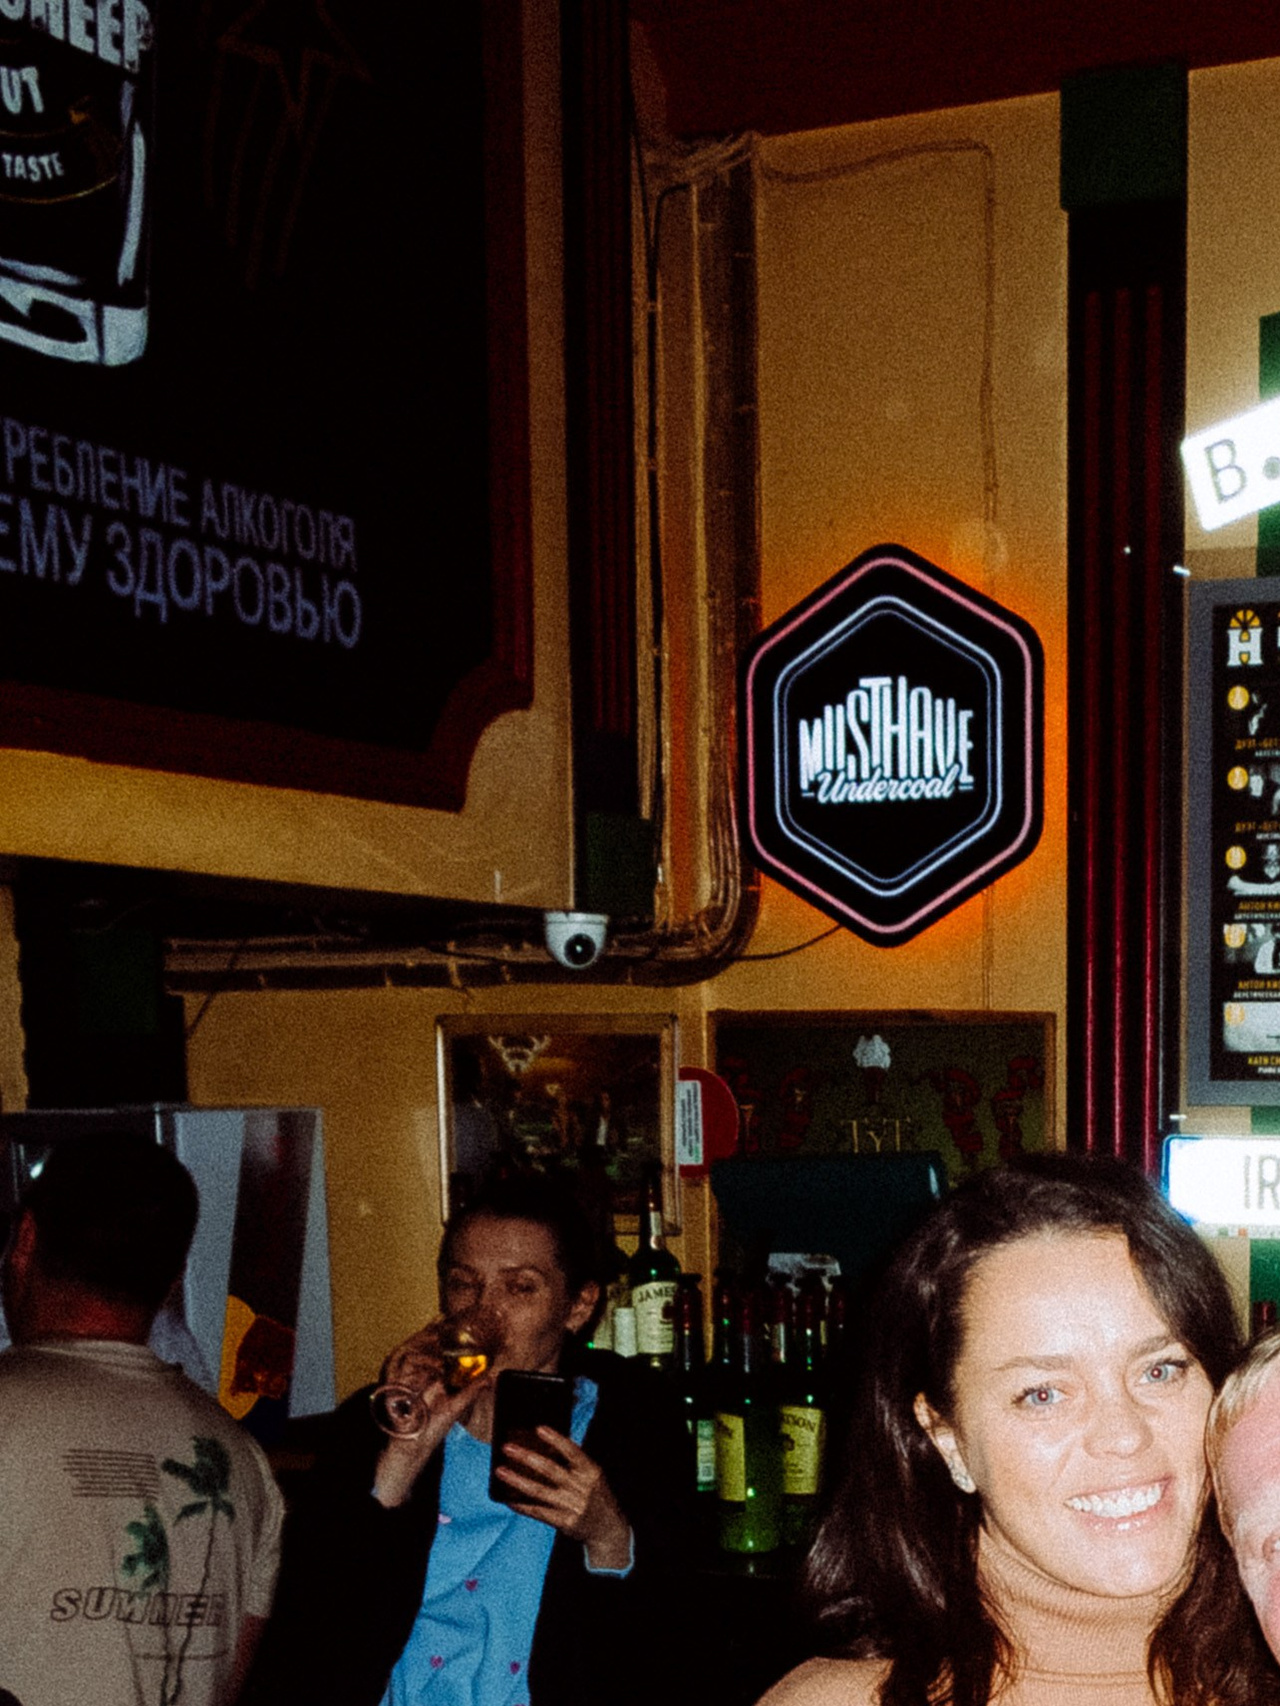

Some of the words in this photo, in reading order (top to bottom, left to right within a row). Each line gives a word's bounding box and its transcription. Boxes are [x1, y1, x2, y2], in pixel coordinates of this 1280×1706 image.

[2, 152, 64, 182] TASTE
[3, 418, 191, 528] РЕБЛЕНИЕ
[201, 479, 358, 572] АЛКОГОЛЯ
[106, 521, 362, 648] ЗДОРОВЬЮ
[817, 763, 959, 804] Undercoal
